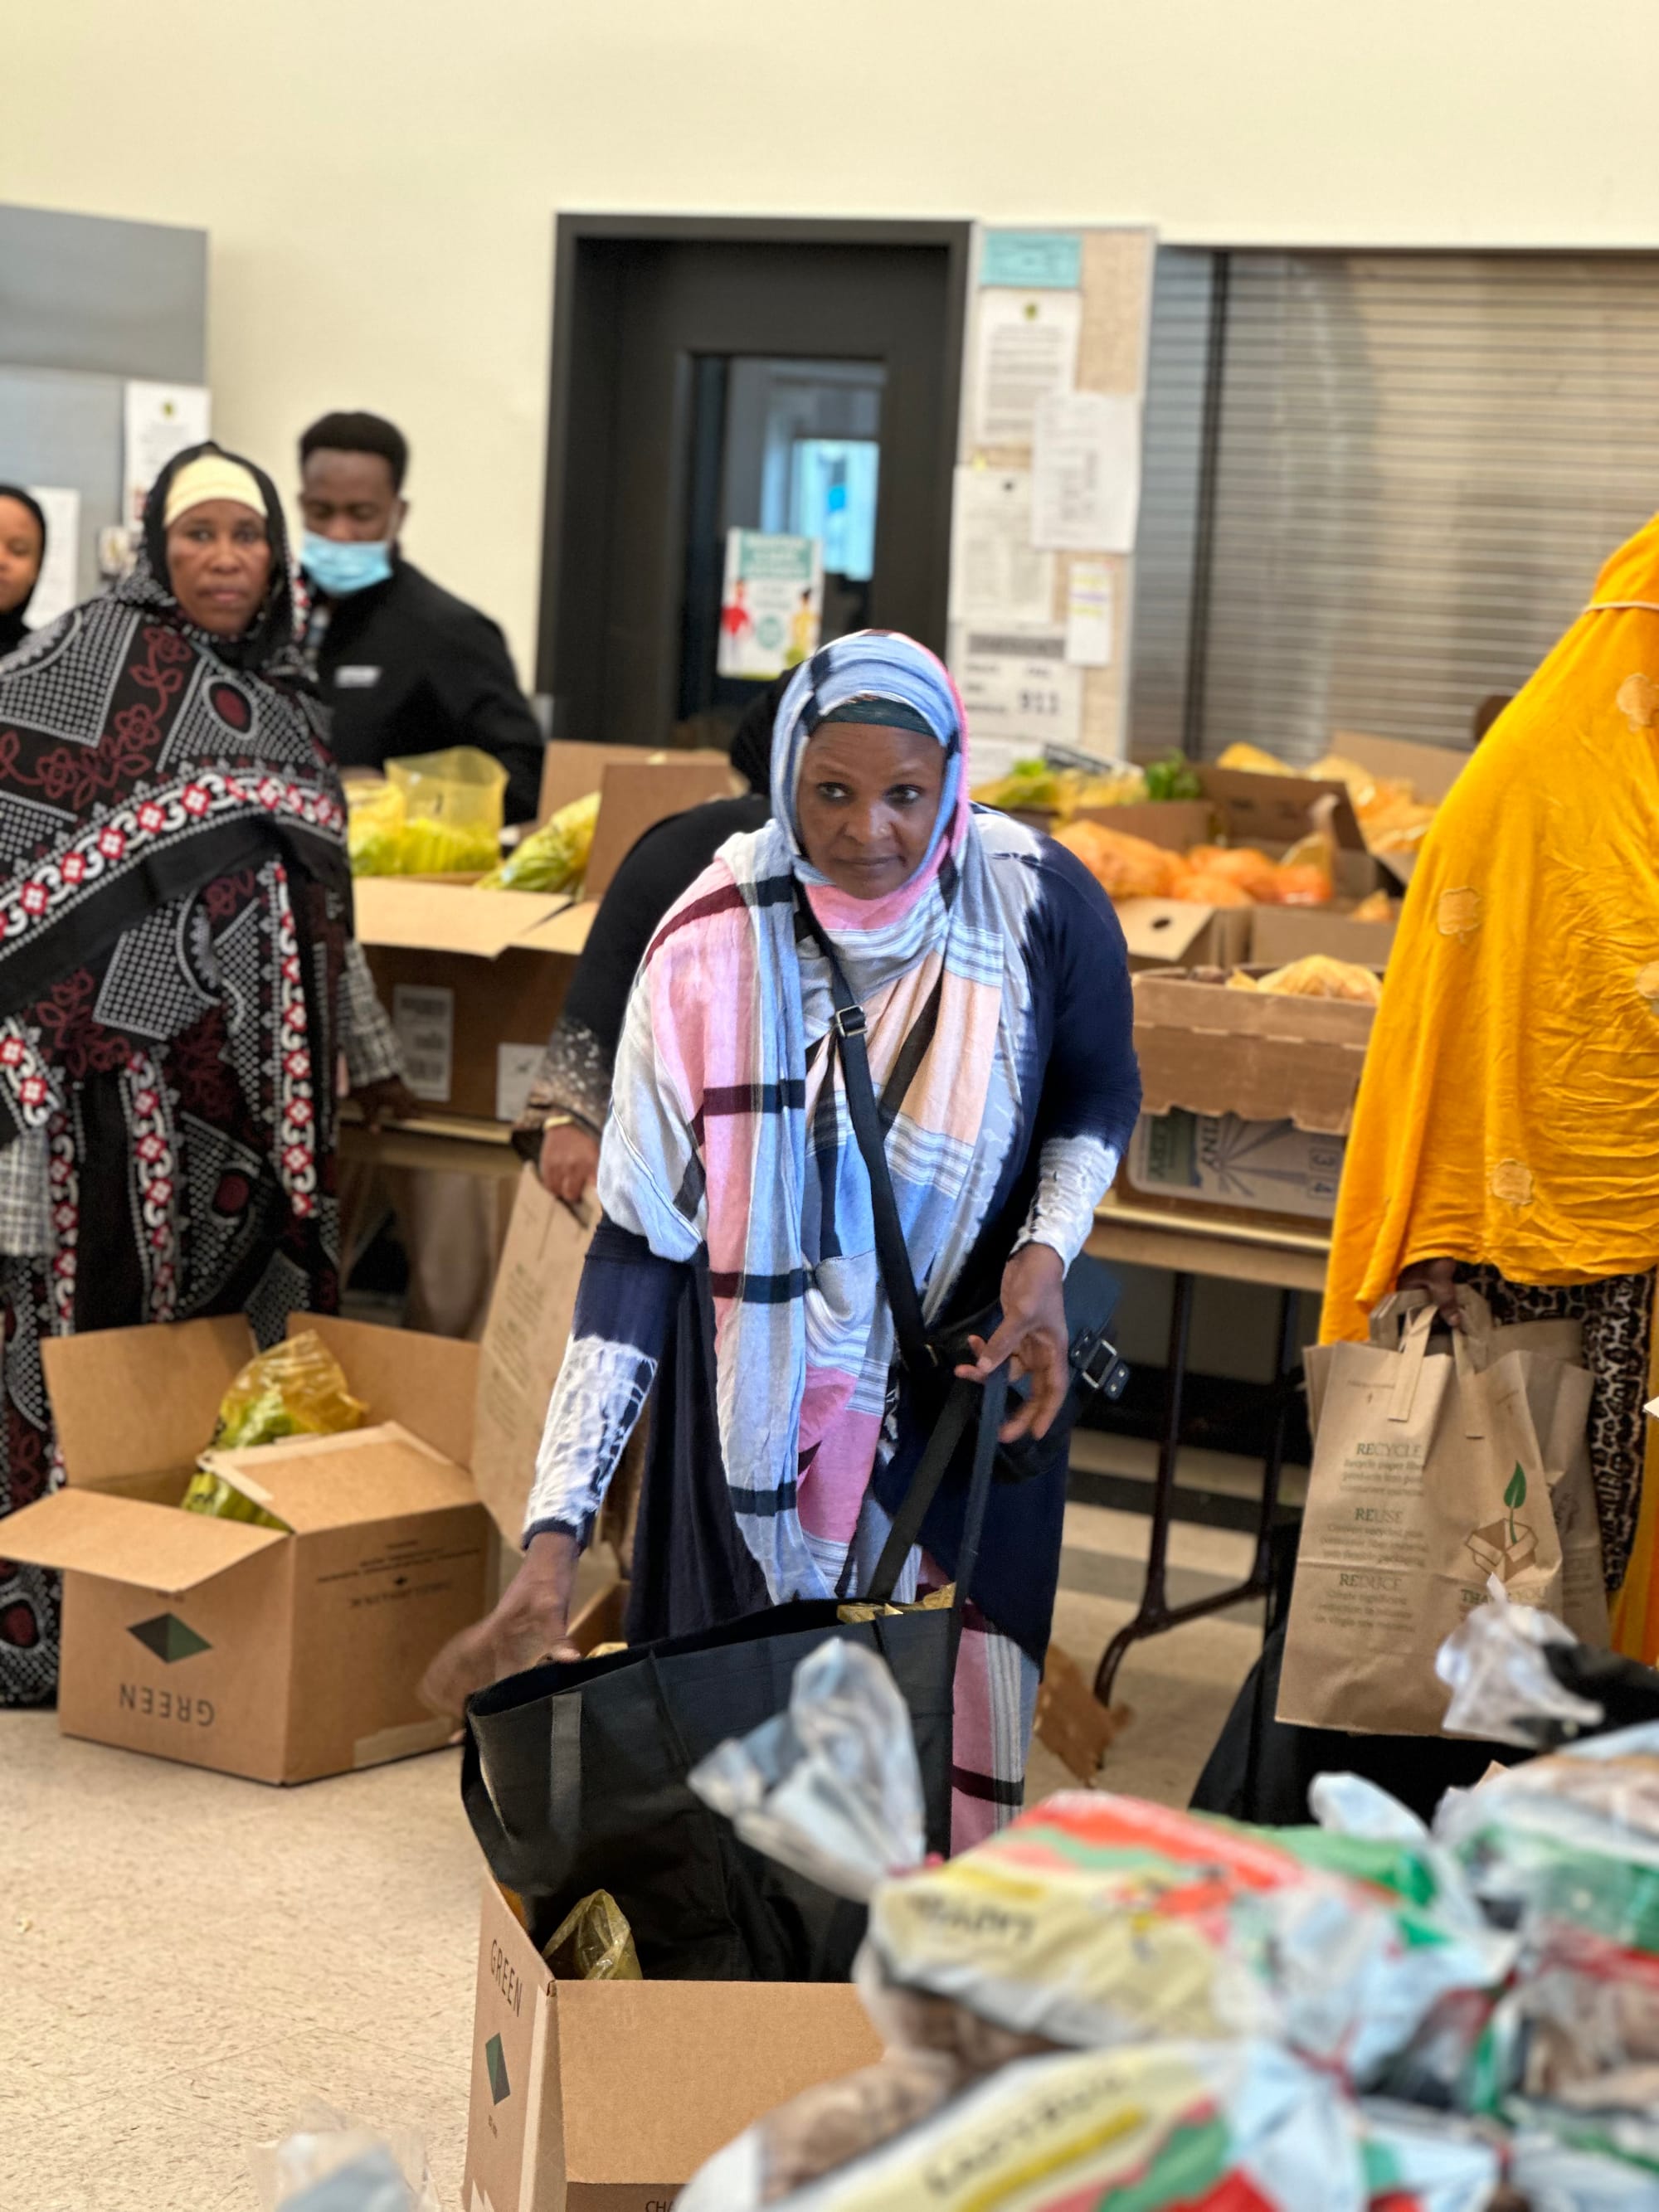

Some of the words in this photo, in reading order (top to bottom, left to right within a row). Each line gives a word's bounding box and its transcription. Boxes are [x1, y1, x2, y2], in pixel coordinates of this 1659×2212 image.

[1356, 1442, 1422, 1457] RECYCLE
[1355, 1507, 1404, 1524] REUSE
[1338, 1573, 1403, 1591] REDUCE
[119, 1683, 215, 1727] GREEN
[490, 1938, 523, 2018] GREEN
